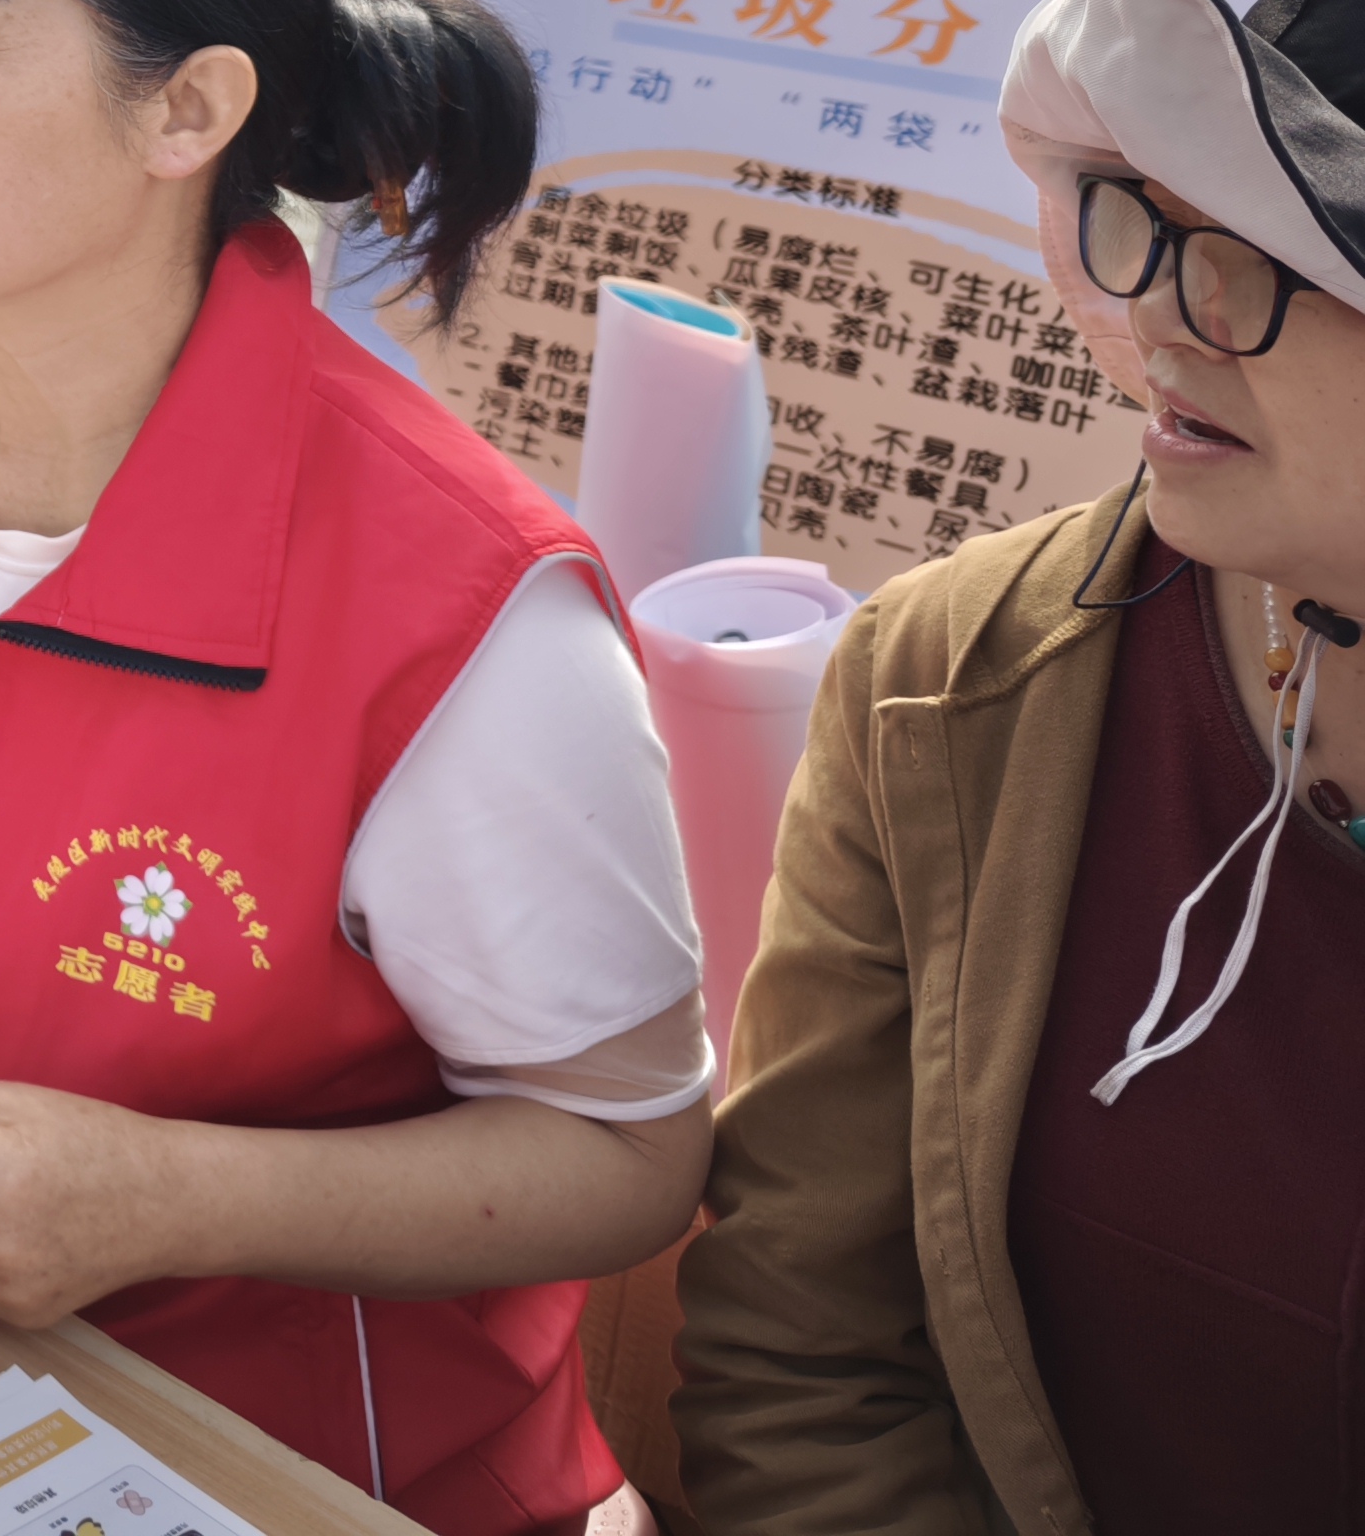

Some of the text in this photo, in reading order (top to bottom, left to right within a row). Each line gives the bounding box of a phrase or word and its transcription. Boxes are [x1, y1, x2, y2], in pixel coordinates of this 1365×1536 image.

[731, 159, 904, 219] 分类标准
[527, 213, 1093, 360] 剩菜剩饭、瓜果皮核、菜叶菜
[55, 944, 217, 1023] 志愿者
